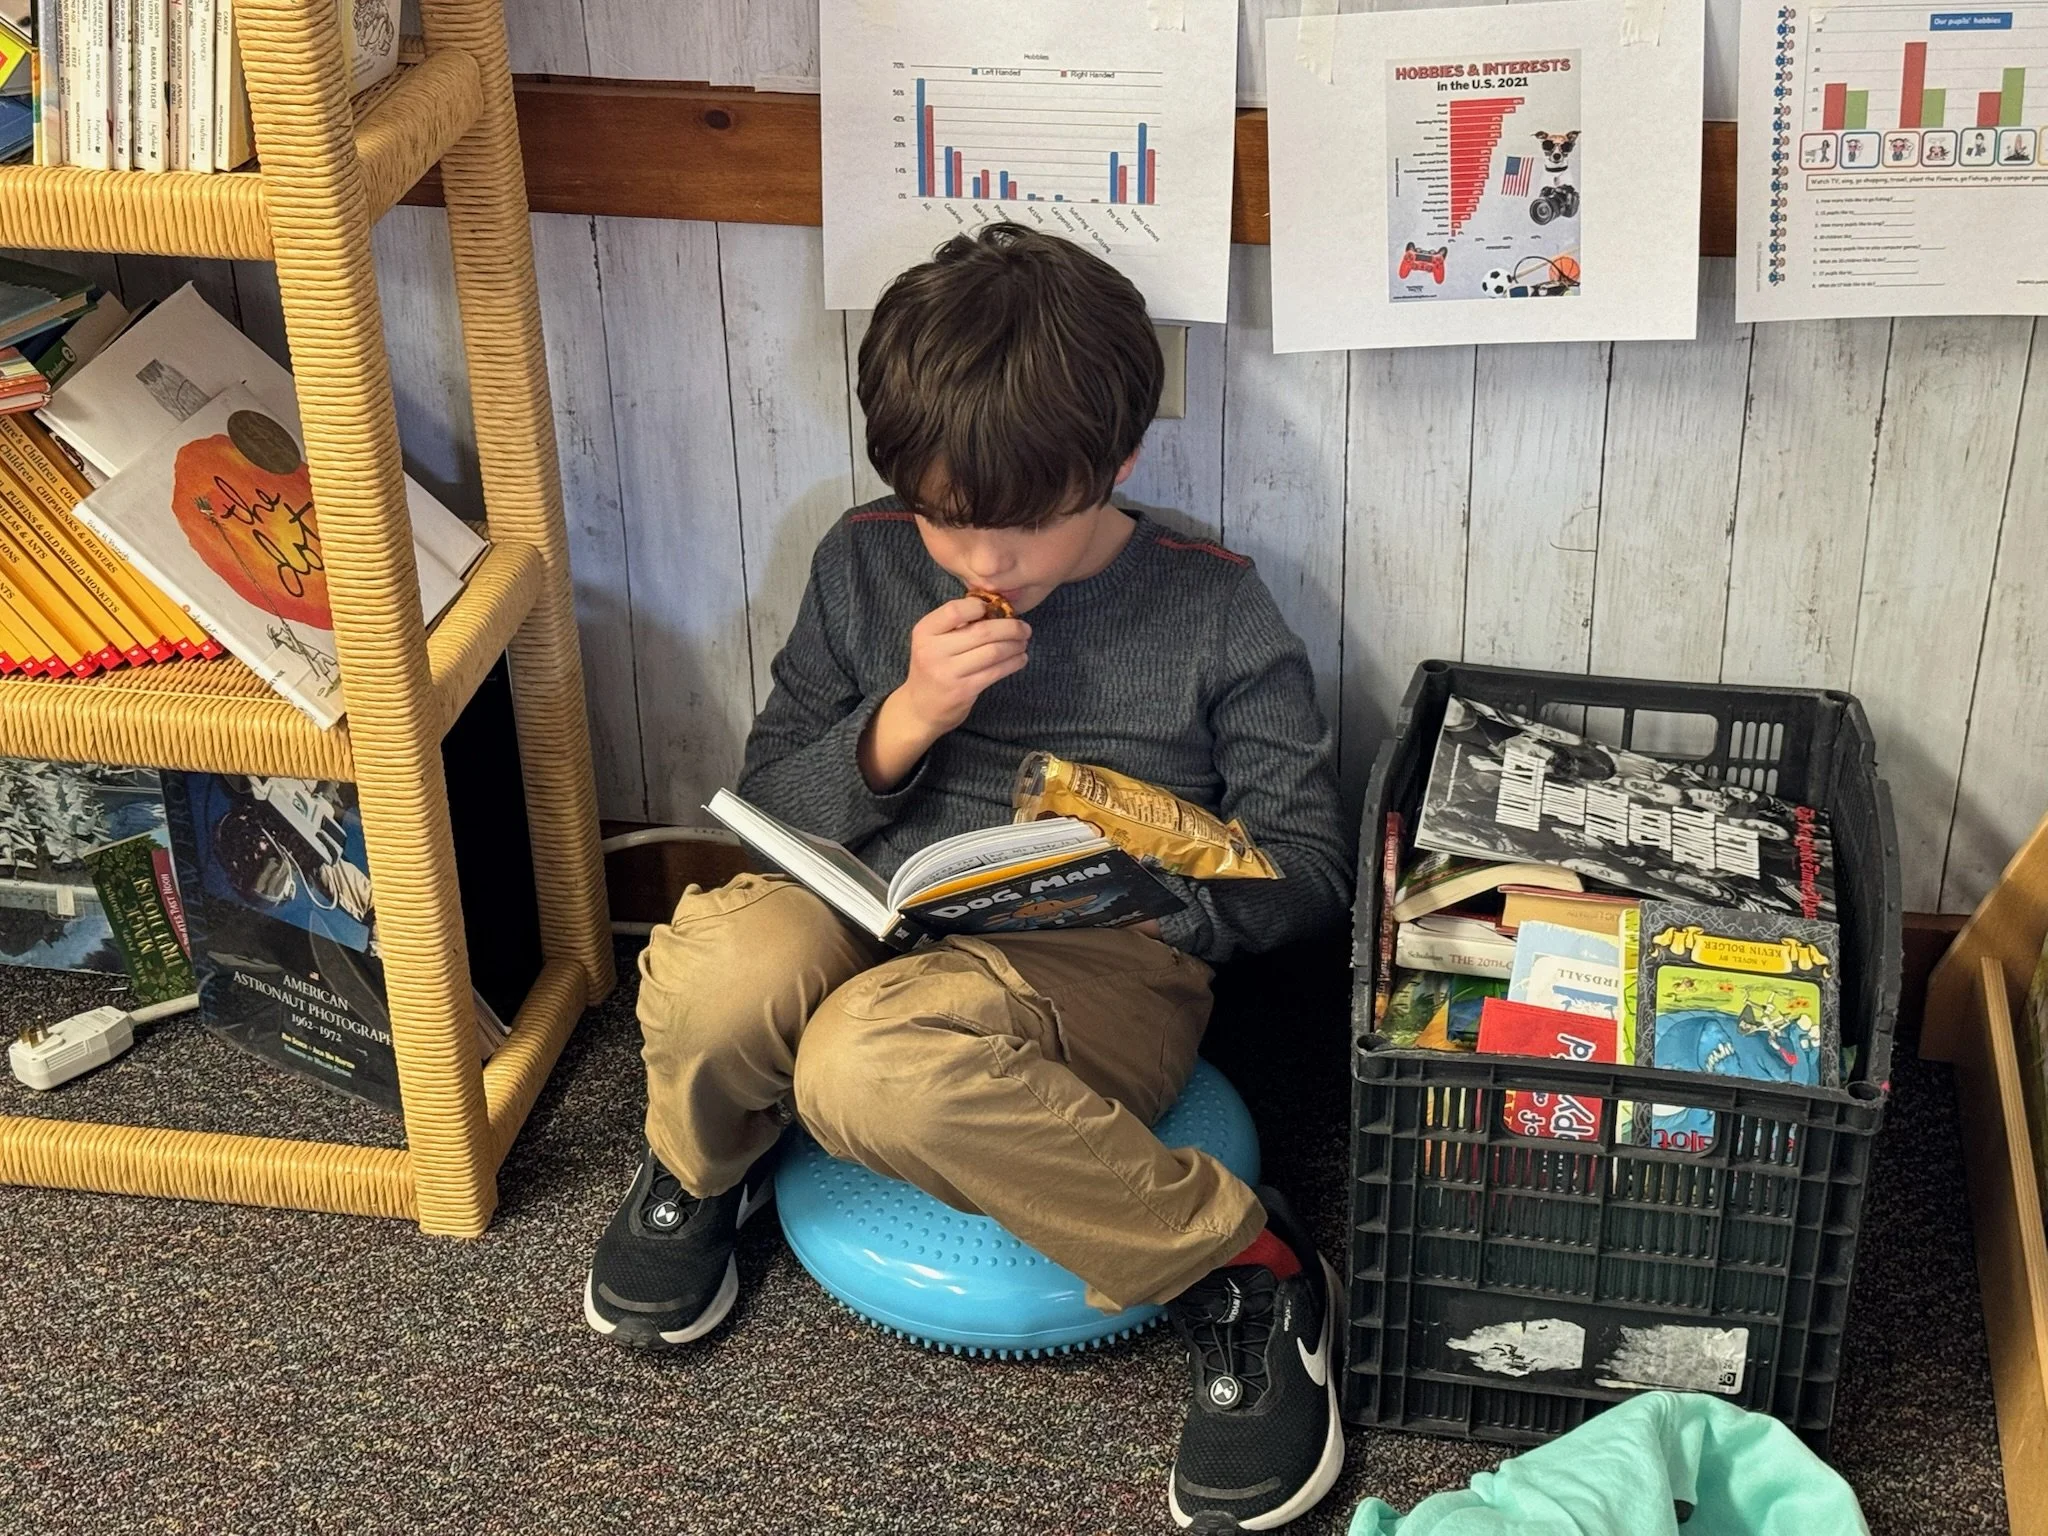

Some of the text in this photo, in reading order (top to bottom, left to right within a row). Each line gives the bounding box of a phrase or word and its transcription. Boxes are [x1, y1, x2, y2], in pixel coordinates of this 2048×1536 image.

[1933, 17, 1947, 25] Our
[1973, 17, 2001, 25] hobbies
[982, 68, 1021, 77] Left Handed
[1070, 70, 1115, 79] Right Handed
[1395, 58, 1571, 80] HOBBIES & INTERESTS
[1437, 77, 1529, 91] in the U.S. 2021
[973, 203, 989, 222] Baking
[1027, 206, 1044, 224] Acting
[1051, 206, 1075, 233] Carpentry
[1106, 208, 1129, 232] Pro Sport
[1130, 208, 1160, 242] Video Games
[0, 415, 24, 443] ture's
[23, 442, 60, 485] Children
[213, 475, 282, 527] the
[0, 504, 49, 560] ILLAS & ANTS
[36, 485, 77, 532] CHIPMUNKS
[76, 530, 87, 542] &
[85, 538, 119, 574] BEAVERS
[6, 489, 120, 614] PUFFINS & OLD WORLD MONKEYS
[252, 500, 326, 598] dot
[1495, 748, 1546, 832] RESTORATION
[1541, 780, 1587, 826] TRUMP
[1585, 783, 1629, 847] FROM THE
[1628, 802, 1672, 851] SCENES
[1386, 835, 1395, 870] SURVIVED
[1715, 822, 1760, 880] RETURN
[1793, 839, 1819, 862] York
[160, 872, 172, 893] NOON
[928, 888, 1023, 919] DOG
[1029, 862, 1112, 895] MAN
[1799, 862, 1820, 893] Times
[167, 891, 182, 913] PAST
[104, 881, 148, 984] MARY POPE OSBORNE
[130, 902, 155, 956] MAGIC
[133, 876, 184, 968] TREE HOUSE
[1450, 954, 1475, 966] THE
[1703, 940, 1782, 958] KEVIN BOLGER
[1718, 954, 1728, 962] BY
[1732, 955, 1758, 964] NOVEL
[233, 970, 306, 1012] ASTRONAUT
[282, 974, 348, 1012] AMERICAN
[1557, 967, 1619, 989] IRDSALL
[1520, 1110, 1545, 1136] of
